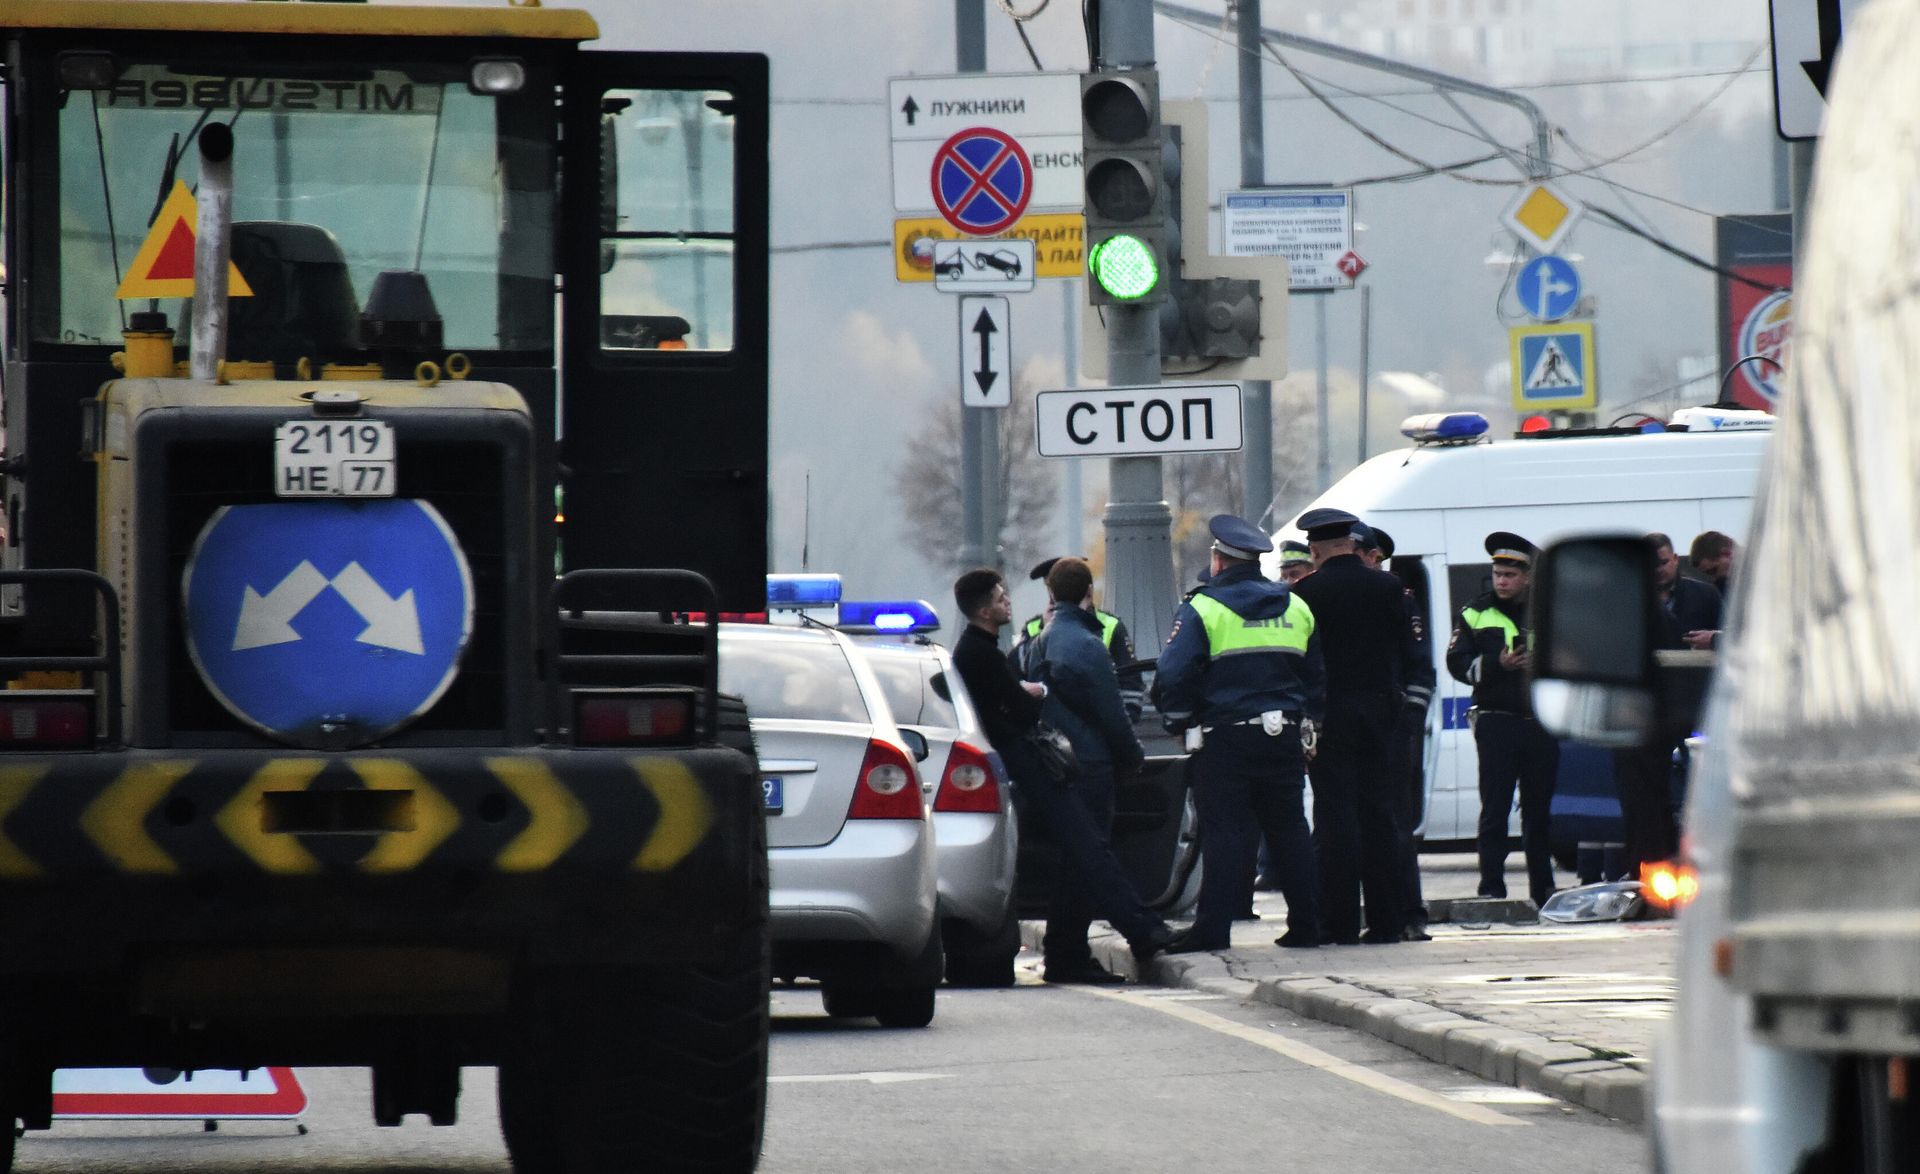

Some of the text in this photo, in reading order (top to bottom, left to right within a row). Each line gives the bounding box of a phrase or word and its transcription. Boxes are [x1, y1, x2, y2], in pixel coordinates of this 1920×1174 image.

[931, 99, 1025, 116] ЛУЖНИКИ
[1066, 397, 1214, 445] СТОП
[289, 424, 380, 454] 2119
[351, 465, 386, 491] 77
